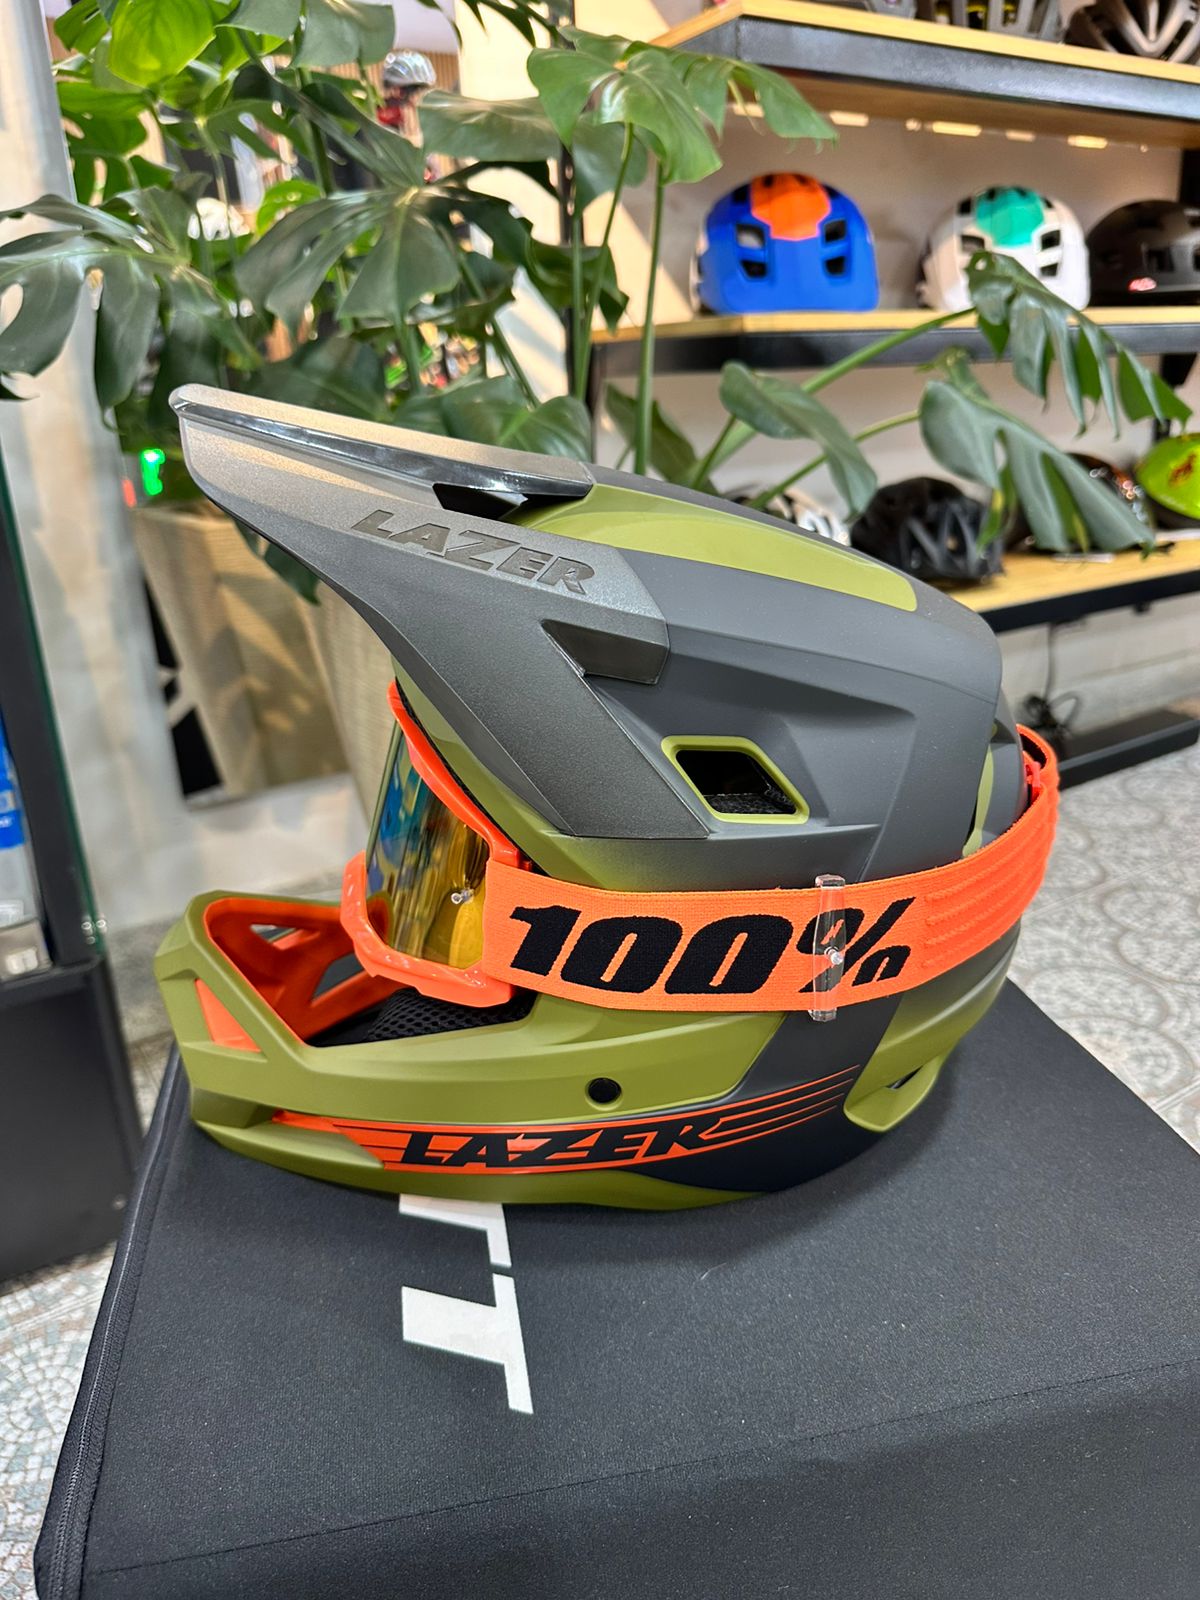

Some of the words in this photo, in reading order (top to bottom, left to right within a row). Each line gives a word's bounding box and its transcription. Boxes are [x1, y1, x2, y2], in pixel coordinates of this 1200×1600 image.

[351, 509, 595, 596] LAZER
[509, 896, 917, 994] 100%
[400, 1112, 722, 1168] LAZER
